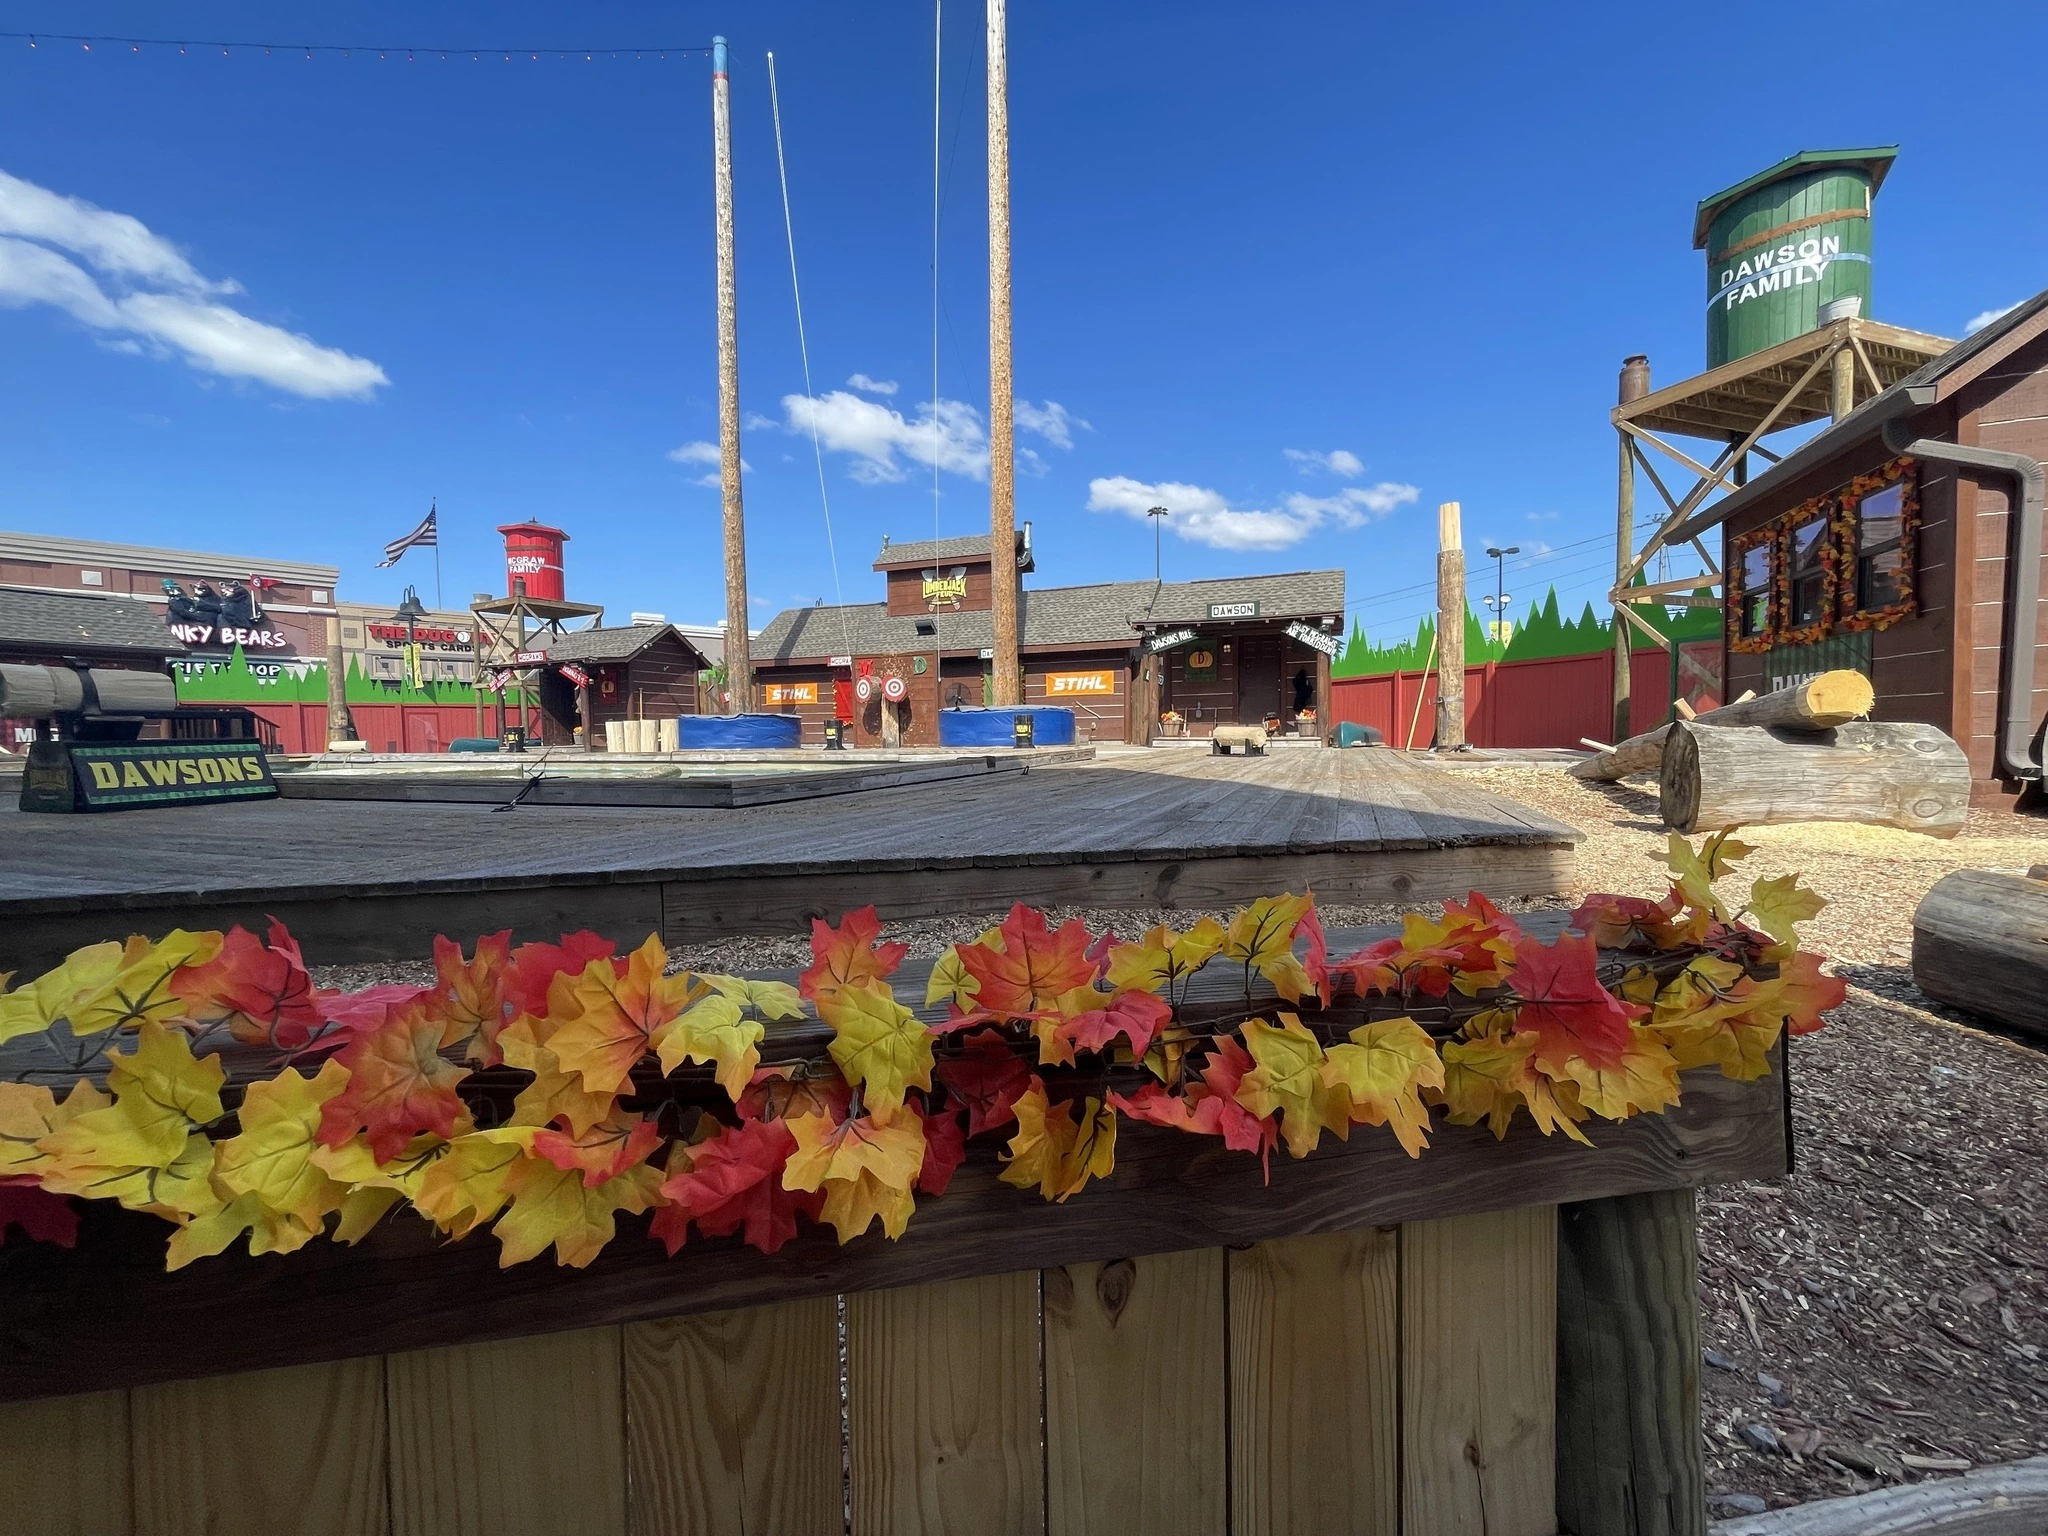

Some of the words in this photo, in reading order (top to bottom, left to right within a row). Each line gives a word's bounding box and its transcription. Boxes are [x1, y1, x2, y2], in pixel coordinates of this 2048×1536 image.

[1720, 235, 1840, 290] DAWSON
[1726, 261, 1830, 311] FAMILY
[509, 564, 541, 575] FAMILY
[922, 577, 968, 600] LUMBERJACK
[1213, 603, 1254, 617] DAWSON
[221, 627, 287, 647] BEARS
[368, 625, 406, 640] THE
[1150, 632, 1179, 651] DAWSONS
[1178, 628, 1193, 641] RULE
[386, 640, 435, 651] SPOTS
[441, 642, 475, 653] CARD
[518, 652, 543, 661] MCGRAWS
[227, 663, 281, 676] HOP
[1053, 675, 1107, 692] STIHL
[771, 687, 813, 701] STIHL
[87, 756, 264, 789] DAWSONS
